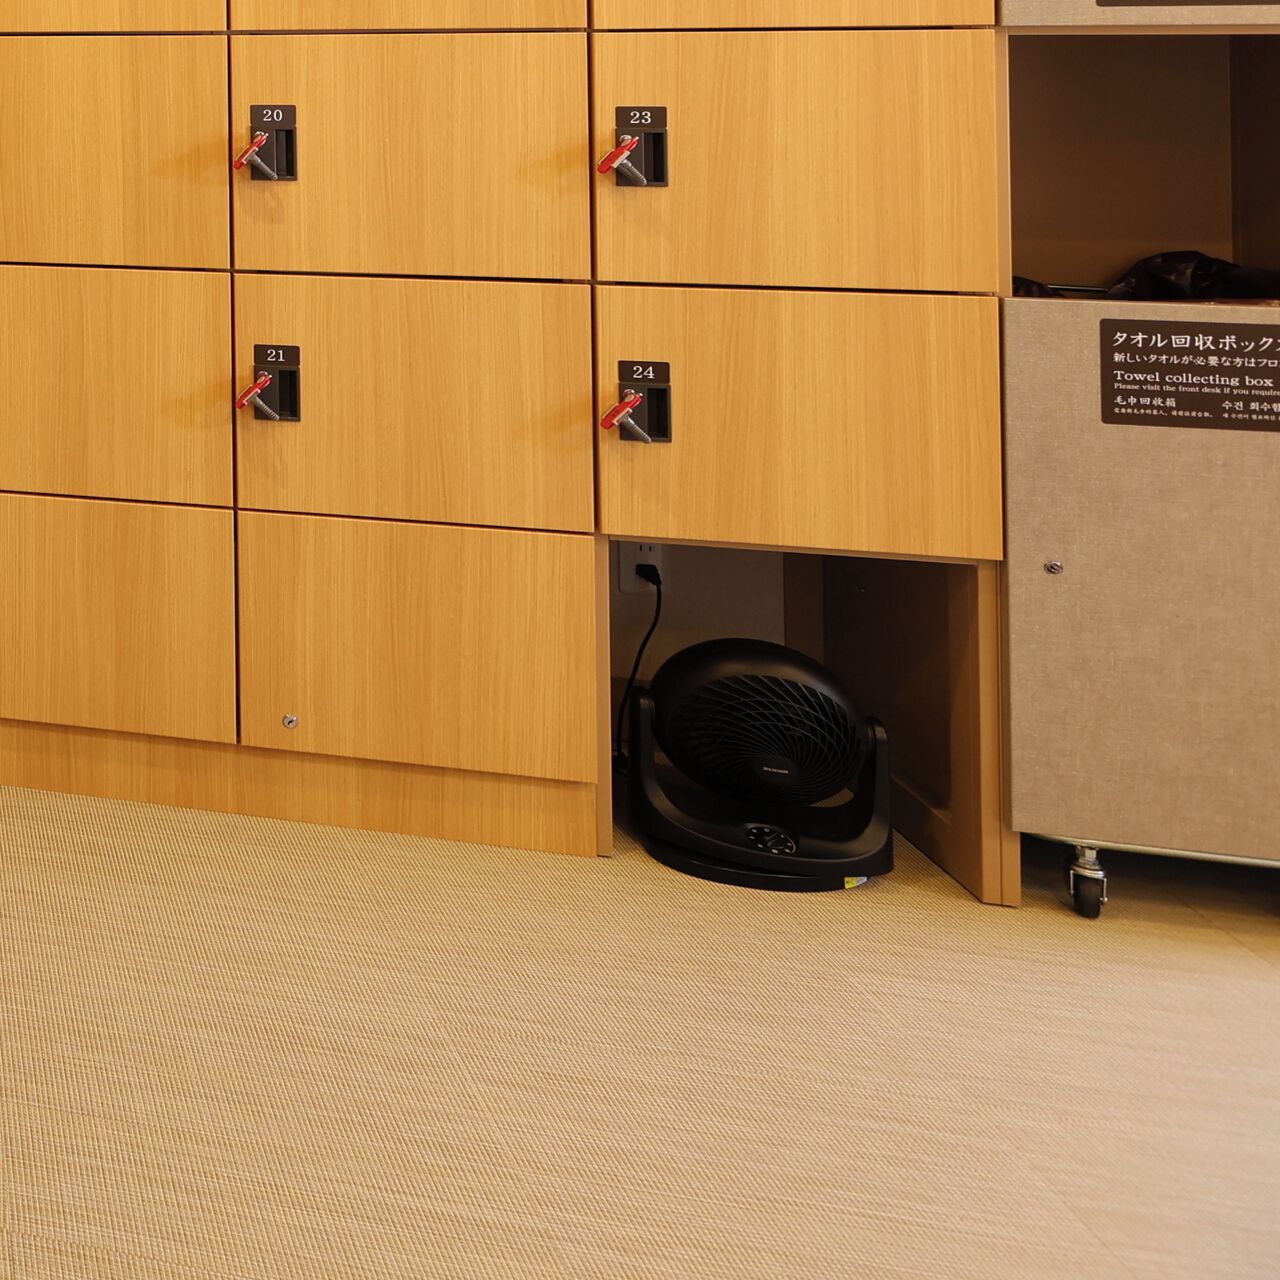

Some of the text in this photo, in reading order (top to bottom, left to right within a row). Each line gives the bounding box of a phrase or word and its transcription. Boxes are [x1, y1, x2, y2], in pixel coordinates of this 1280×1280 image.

[264, 110, 282, 122] 20
[630, 112, 652, 124] 23
[268, 350, 284, 362] 21
[632, 366, 654, 378] 24
[1114, 371, 1274, 387] Towel collecting box
